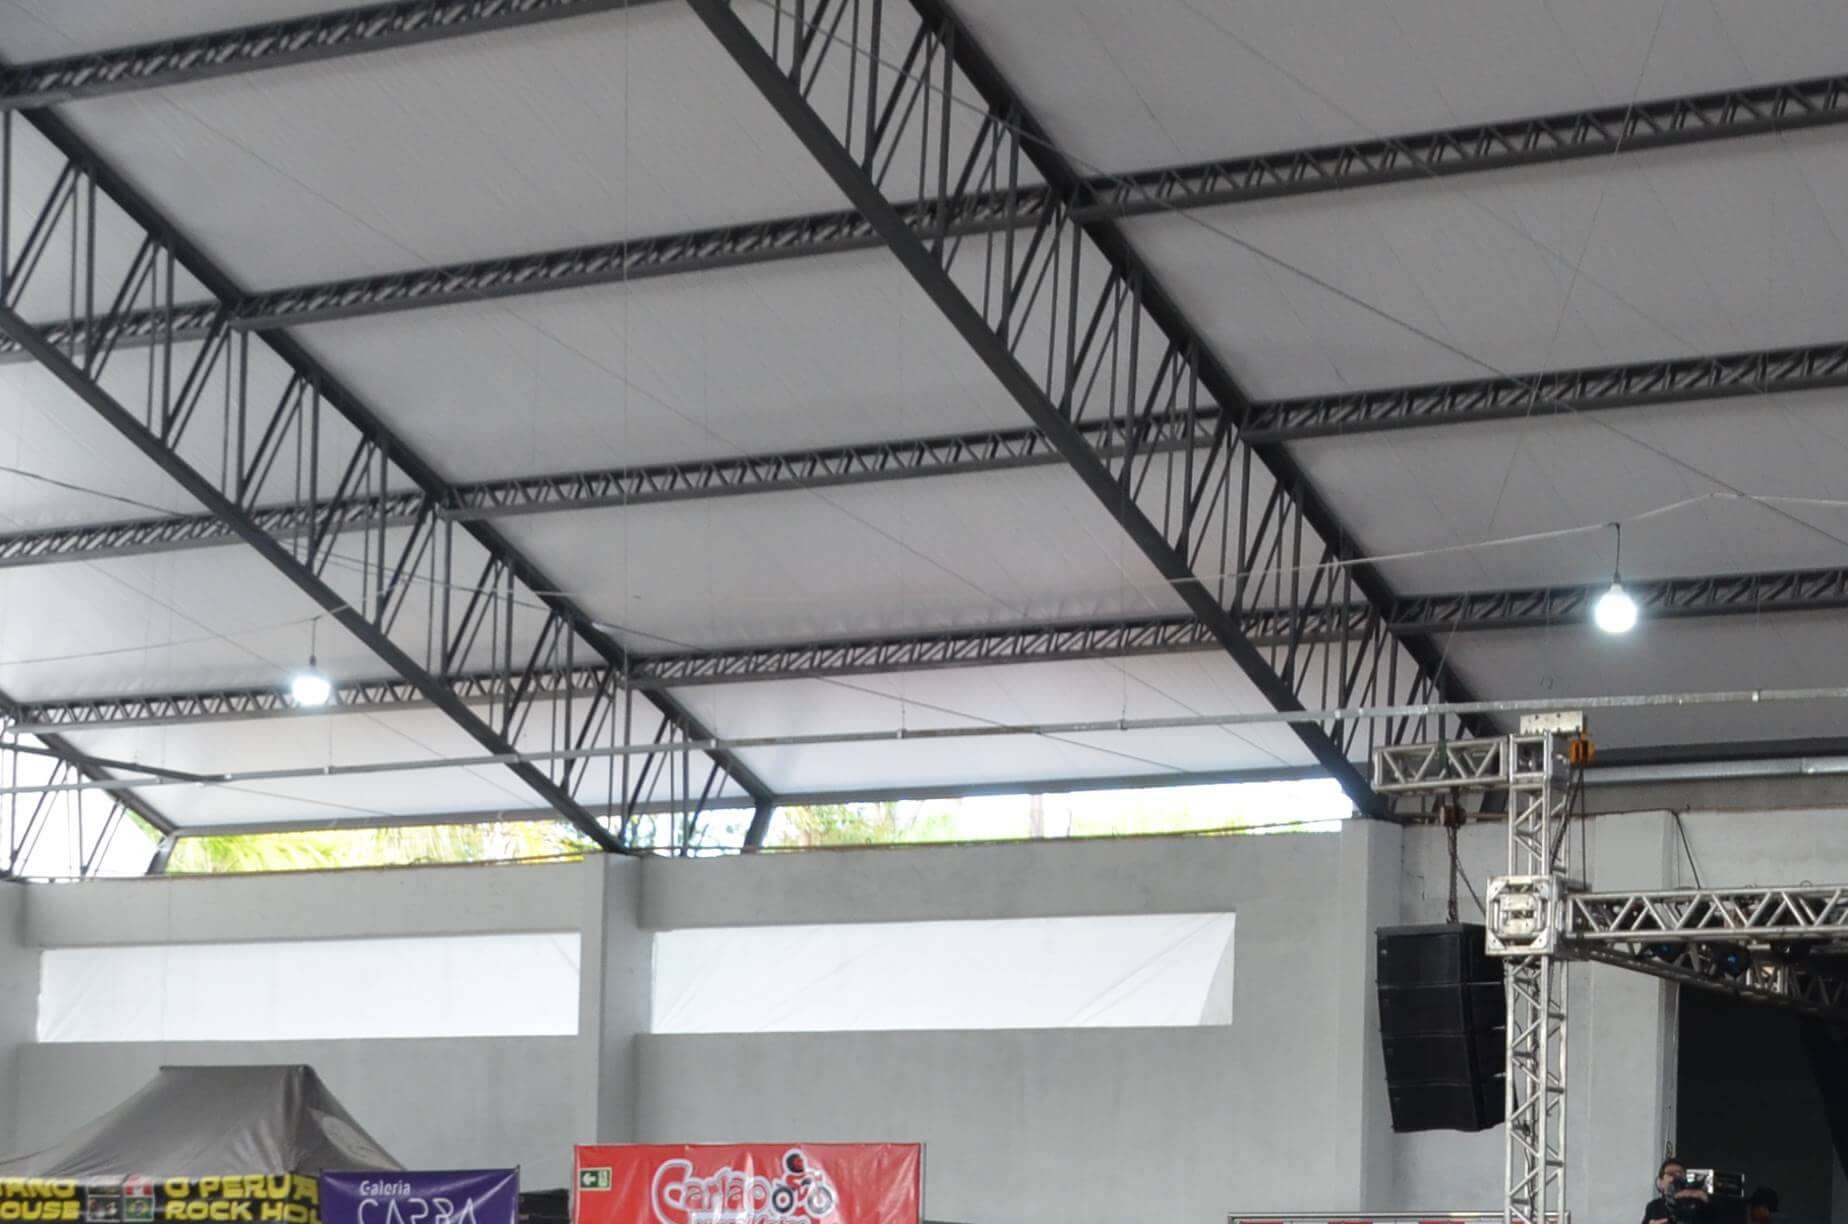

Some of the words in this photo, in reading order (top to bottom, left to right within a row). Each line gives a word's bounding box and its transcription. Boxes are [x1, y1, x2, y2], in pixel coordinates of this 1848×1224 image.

[0, 1177, 75, 1198] ANO
[165, 1177, 190, 1198] O
[360, 1180, 411, 1196] Galeria
[0, 1200, 80, 1220] OUSE
[165, 1200, 253, 1221] ROCK
